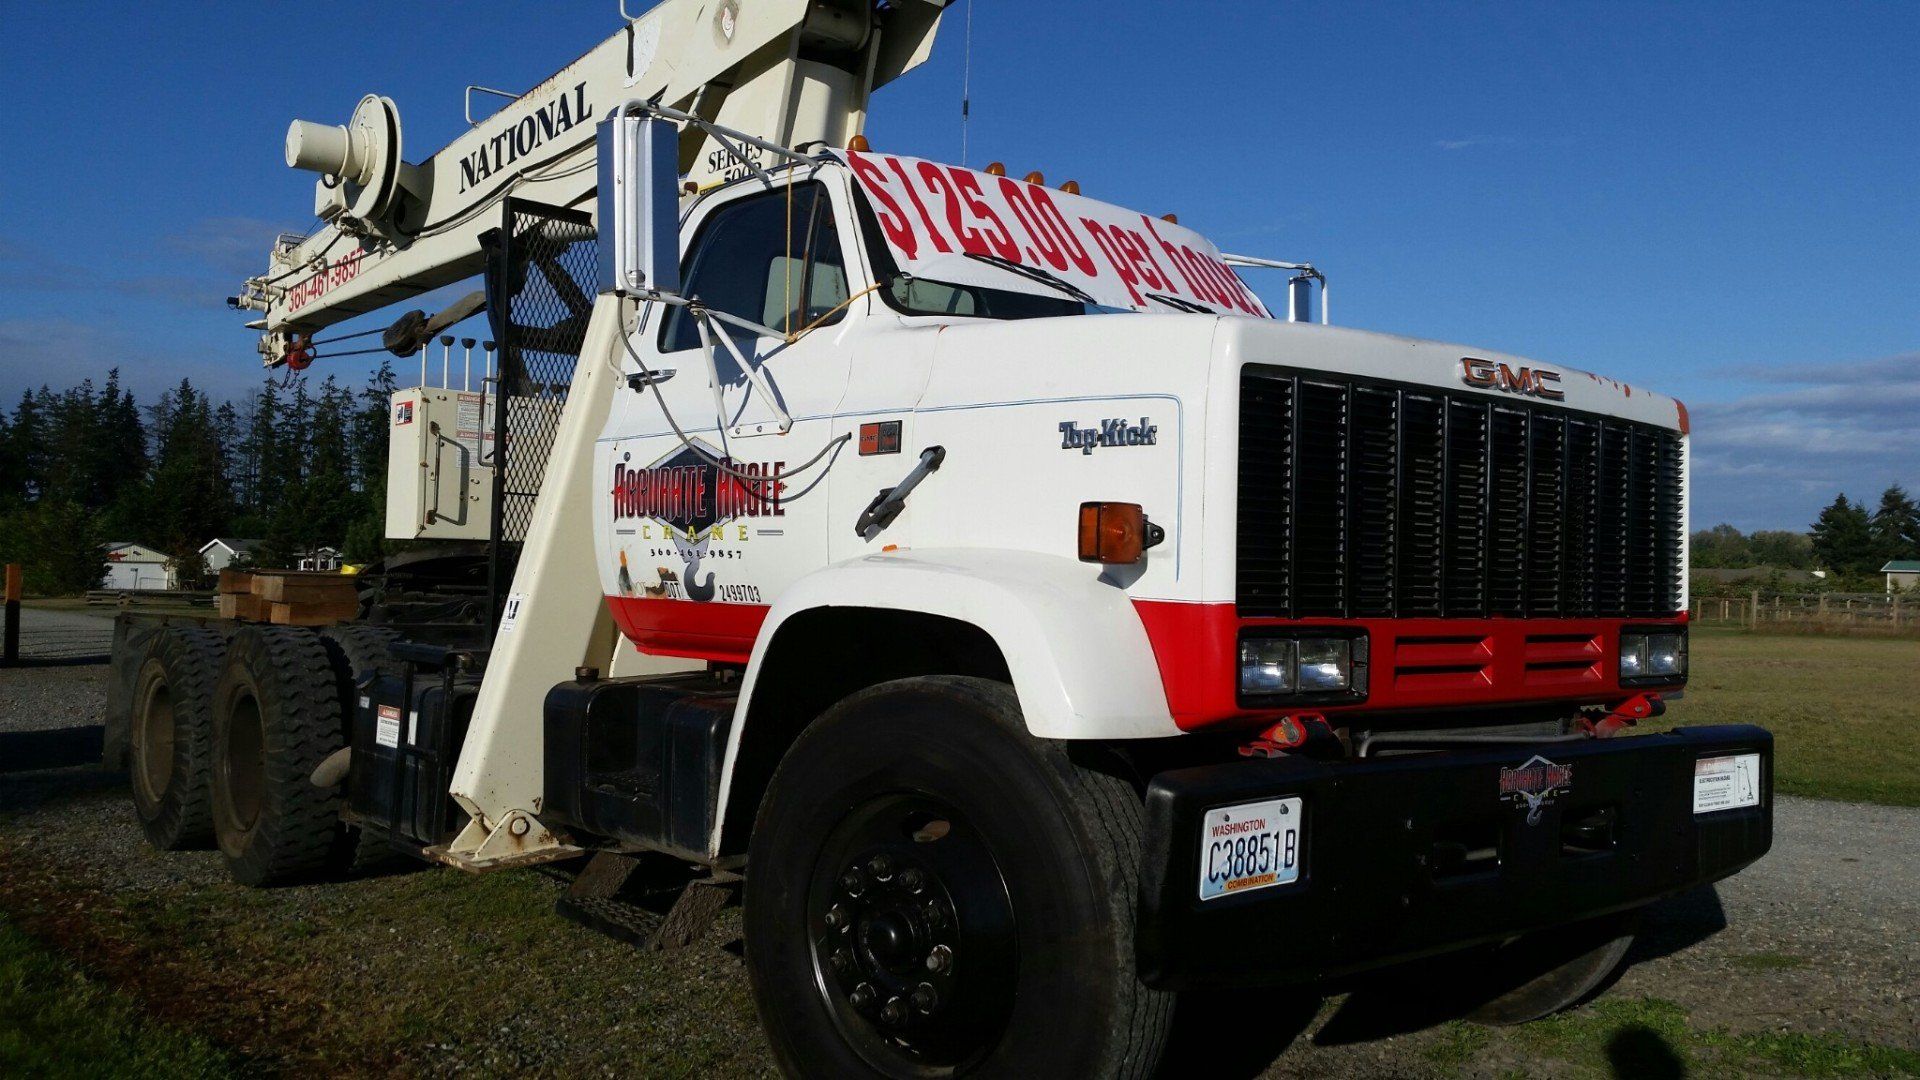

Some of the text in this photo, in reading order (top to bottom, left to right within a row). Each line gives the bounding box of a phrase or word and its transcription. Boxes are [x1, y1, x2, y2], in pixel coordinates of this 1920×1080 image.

[459, 81, 592, 194] NATIONAL
[708, 136, 763, 174] SERIES
[846, 151, 1097, 277] $125.00
[1079, 217, 1179, 307] per
[288, 247, 364, 312] 360-461-9857
[1460, 357, 1565, 402] GMC
[715, 457, 787, 524] ANGLE
[642, 525, 749, 541] CRANE
[719, 584, 761, 603] 2499703
[1211, 818, 1266, 837] WASHINGTON
[1208, 828, 1296, 884] C38851B
[1227, 873, 1275, 890] COMBINATION
